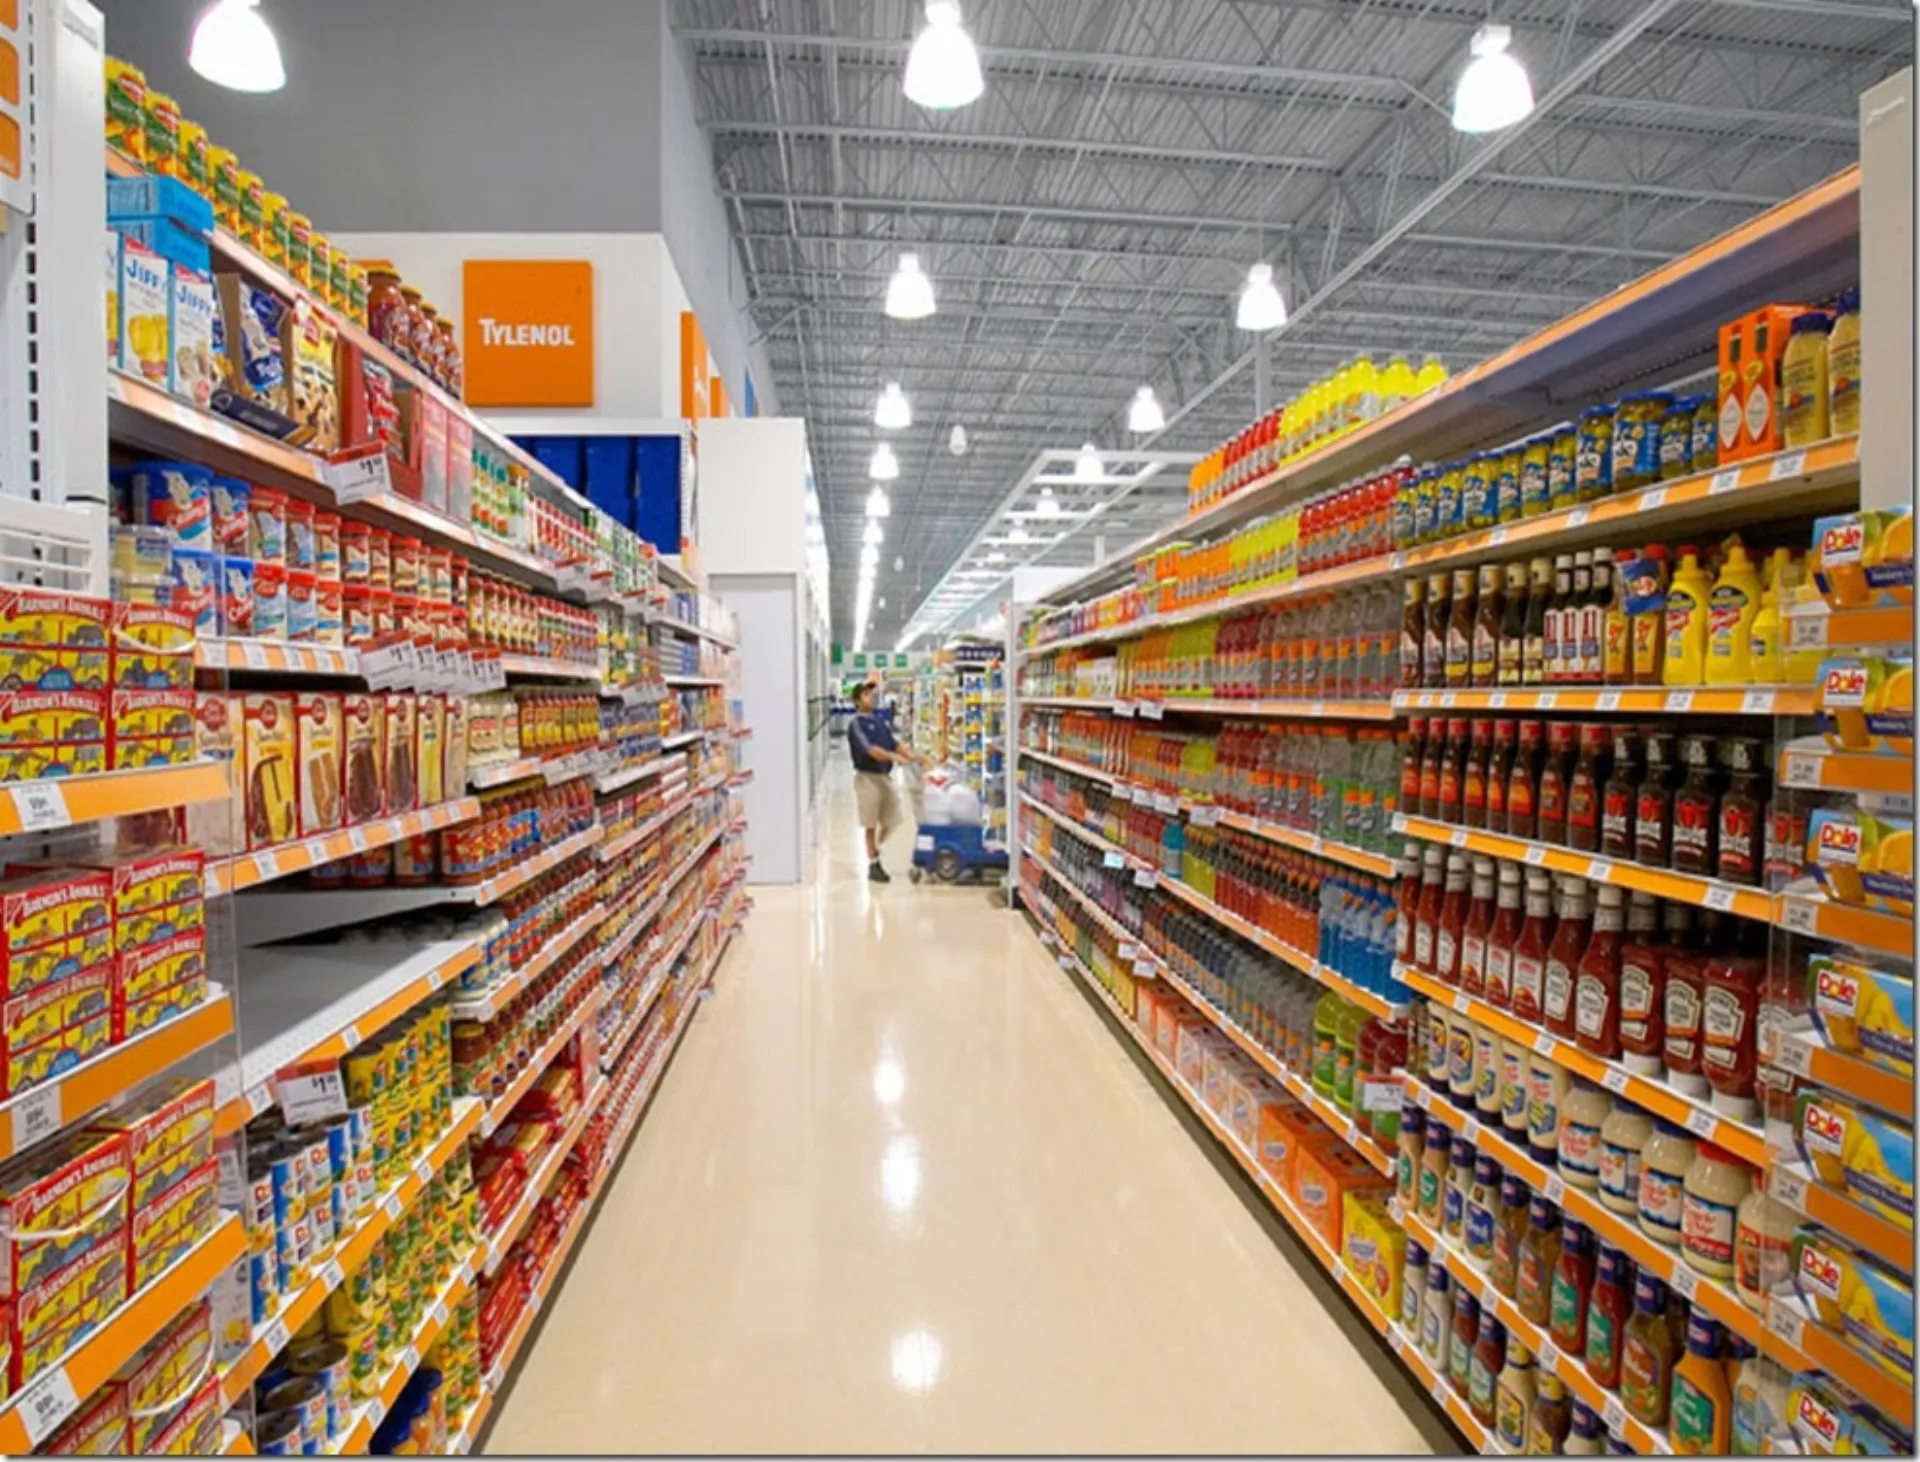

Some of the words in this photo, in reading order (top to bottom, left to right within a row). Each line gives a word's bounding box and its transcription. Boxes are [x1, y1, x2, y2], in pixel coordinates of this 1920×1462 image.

[478, 317, 575, 346] TYLENOL
[1824, 527, 1861, 549] Dole
[1827, 670, 1864, 692] Dole
[1821, 823, 1858, 848] Dole
[1819, 972, 1856, 999] Dole
[1806, 1106, 1842, 1137] Dole
[1803, 1247, 1839, 1284] Dole
[1800, 1395, 1836, 1434] Dole
